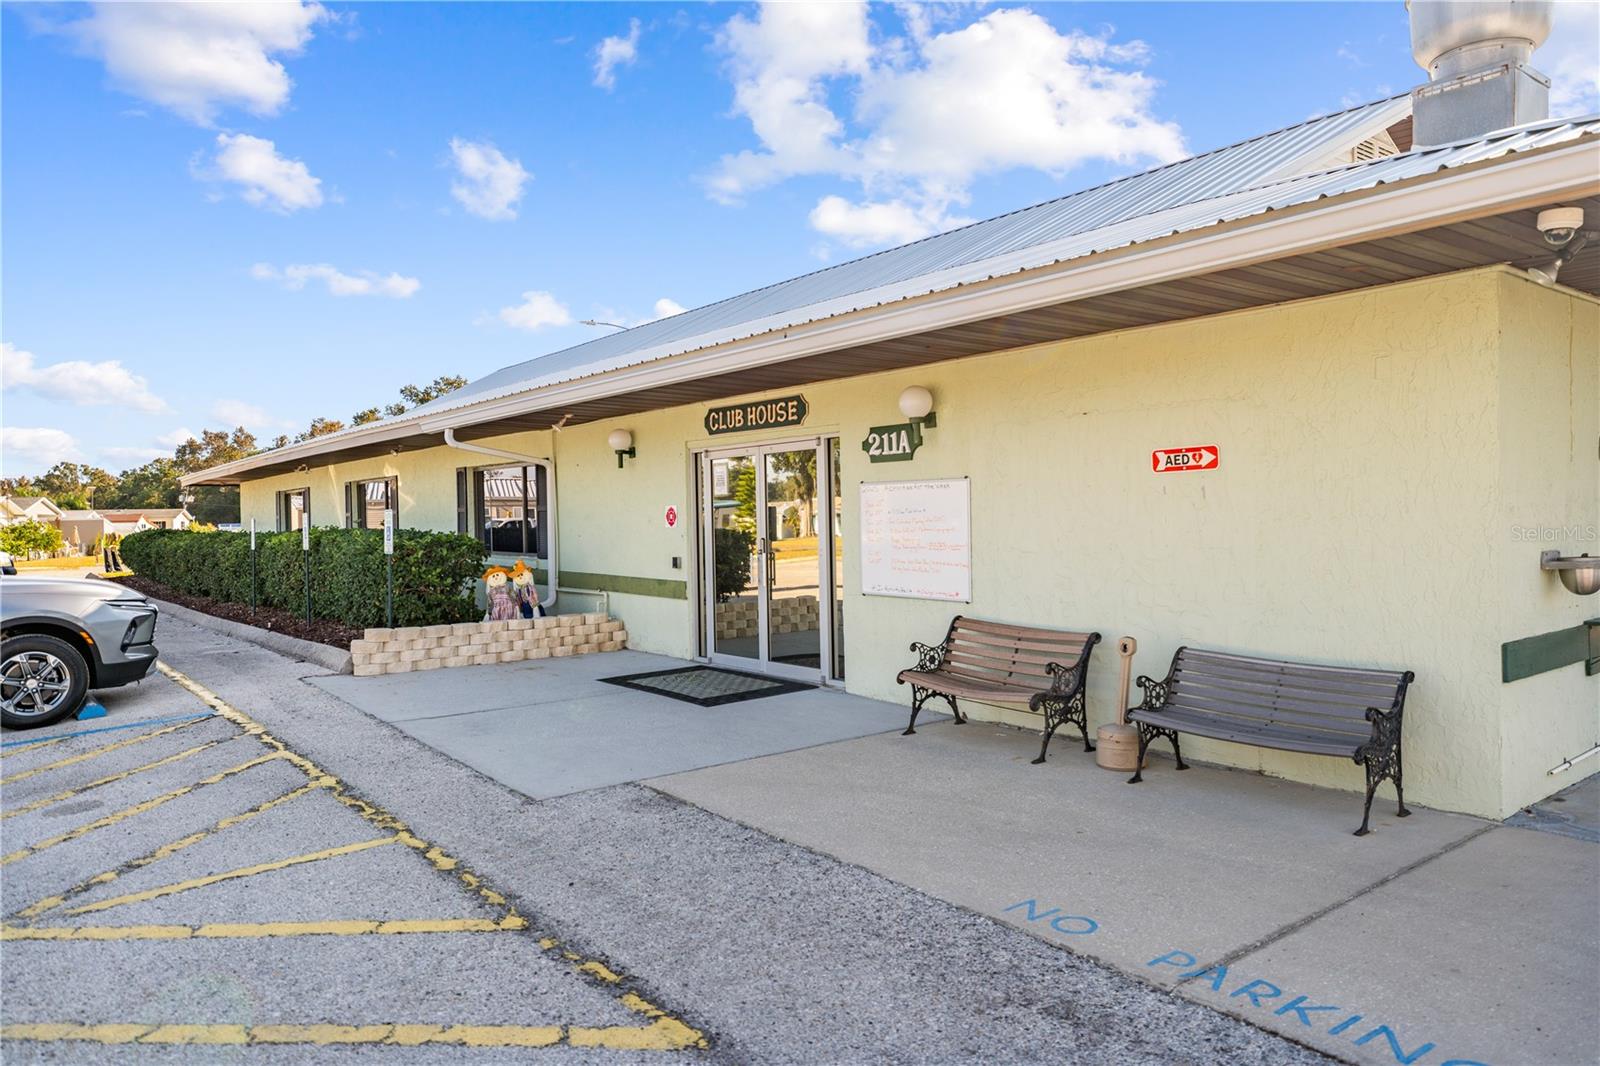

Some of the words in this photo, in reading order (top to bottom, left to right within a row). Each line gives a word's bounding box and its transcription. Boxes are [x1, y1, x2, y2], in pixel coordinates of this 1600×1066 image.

[709, 408, 744, 432] CLUB
[747, 400, 799, 426] HOUSE
[867, 430, 911, 457] 211A
[1165, 453, 1190, 466] AED
[1003, 899, 1099, 936] NO
[1146, 949, 1492, 1066] PARKIN
